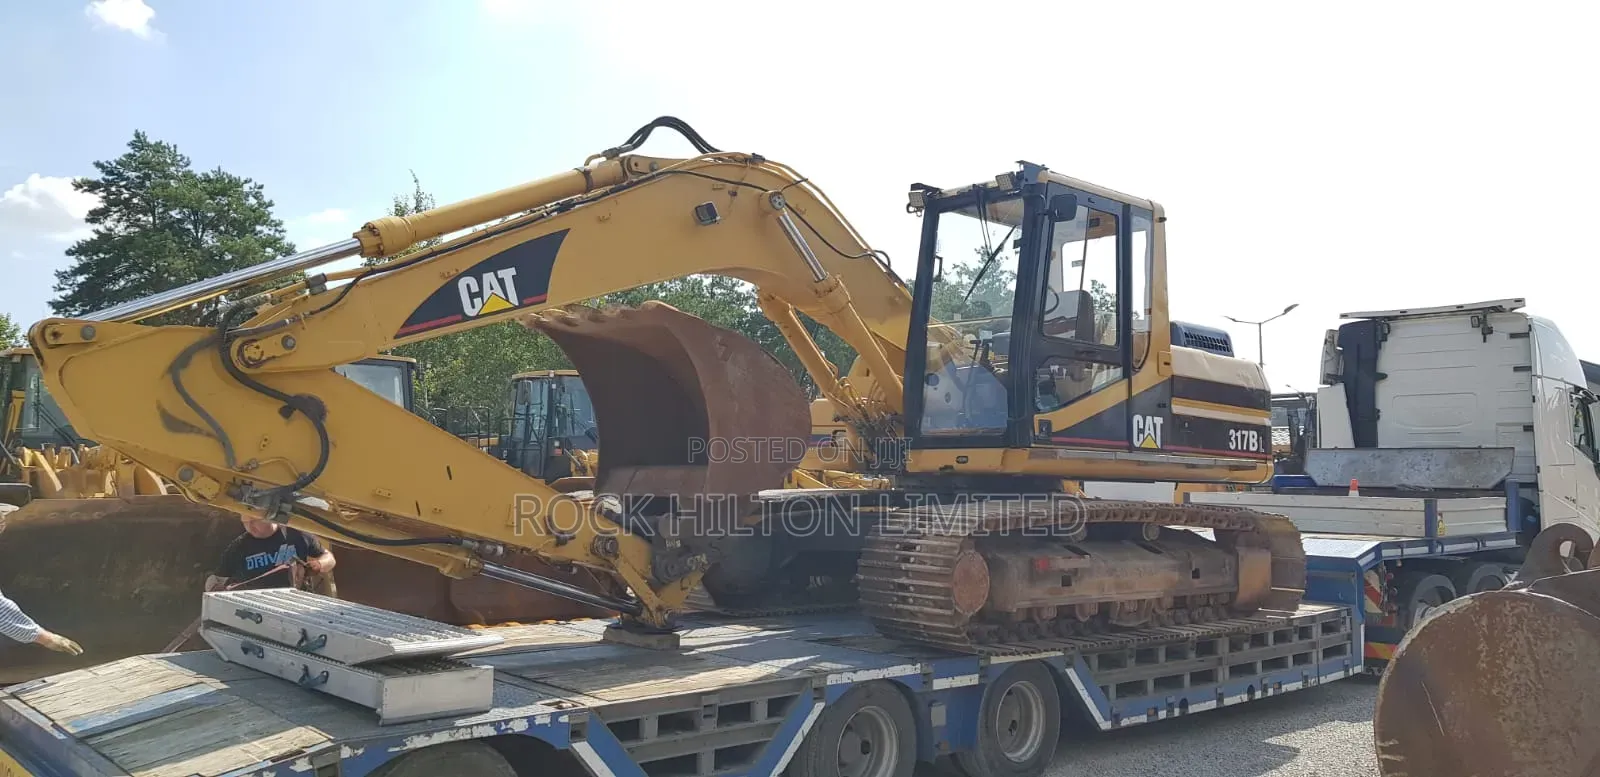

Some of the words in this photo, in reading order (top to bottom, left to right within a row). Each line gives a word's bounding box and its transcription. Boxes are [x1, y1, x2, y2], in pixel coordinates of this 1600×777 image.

[457, 266, 519, 317] CAT
[1132, 414, 1164, 449] CAT
[1228, 428, 1258, 451] 317B
